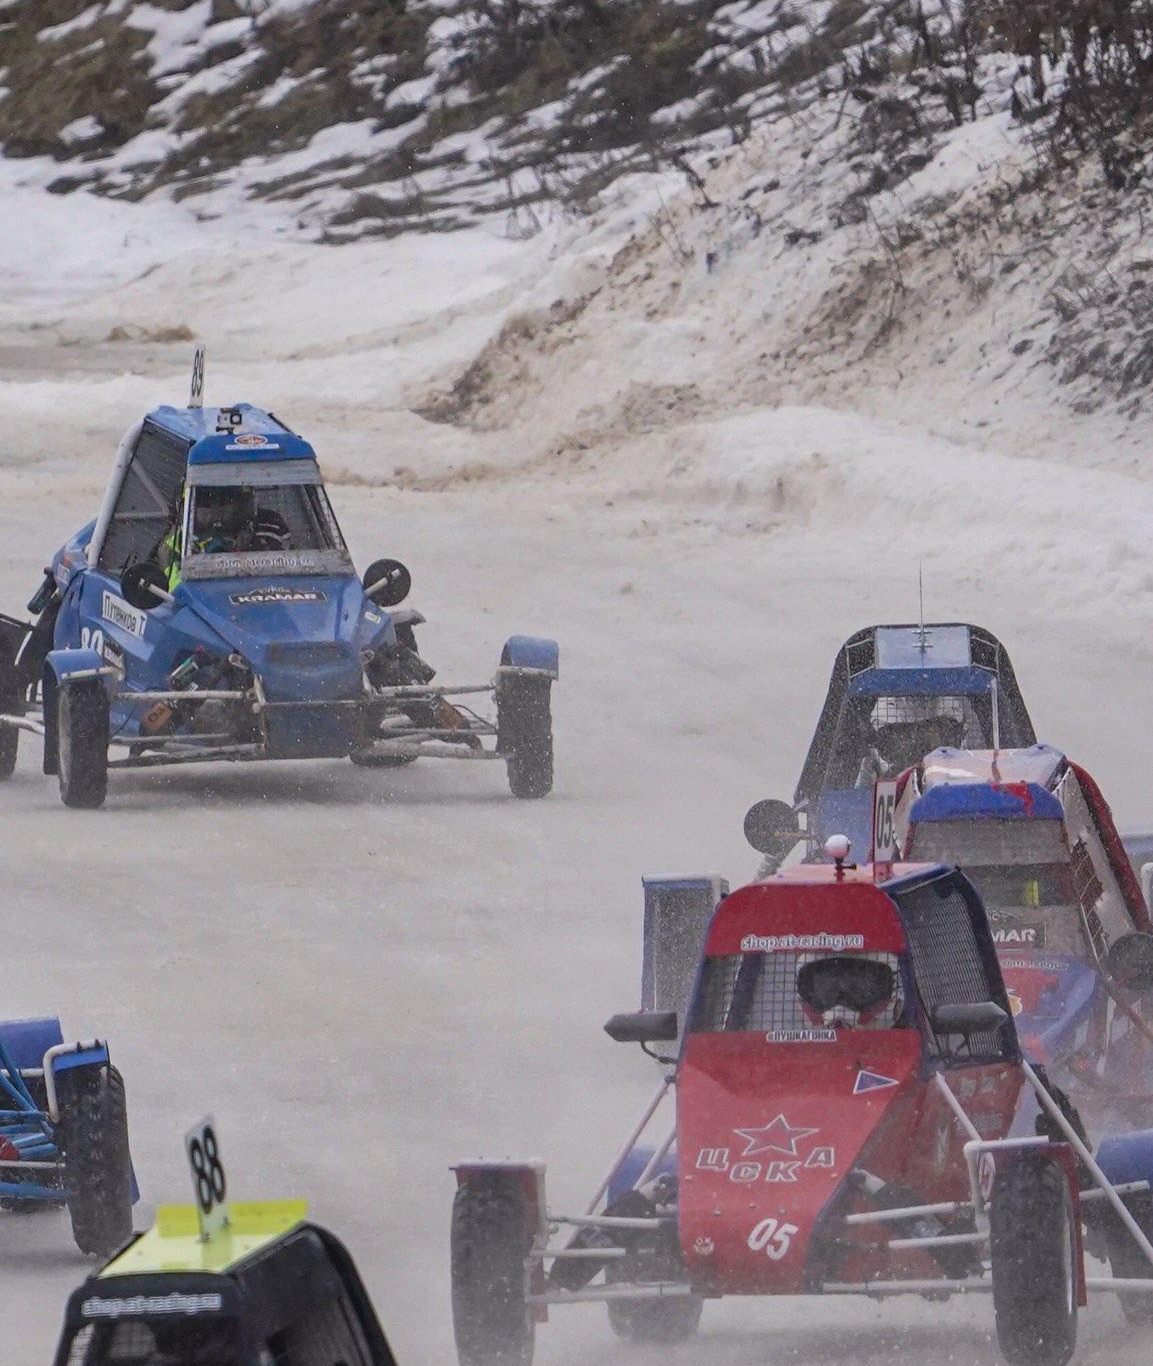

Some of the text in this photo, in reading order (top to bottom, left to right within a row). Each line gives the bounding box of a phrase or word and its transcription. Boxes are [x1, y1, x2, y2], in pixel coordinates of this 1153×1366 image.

[191, 349, 204, 397] 89
[238, 593, 317, 603] KRAMAR
[740, 932, 864, 952] shop.at-racing.ru
[190, 1125, 226, 1214] 88
[748, 1218, 799, 1260] 05
